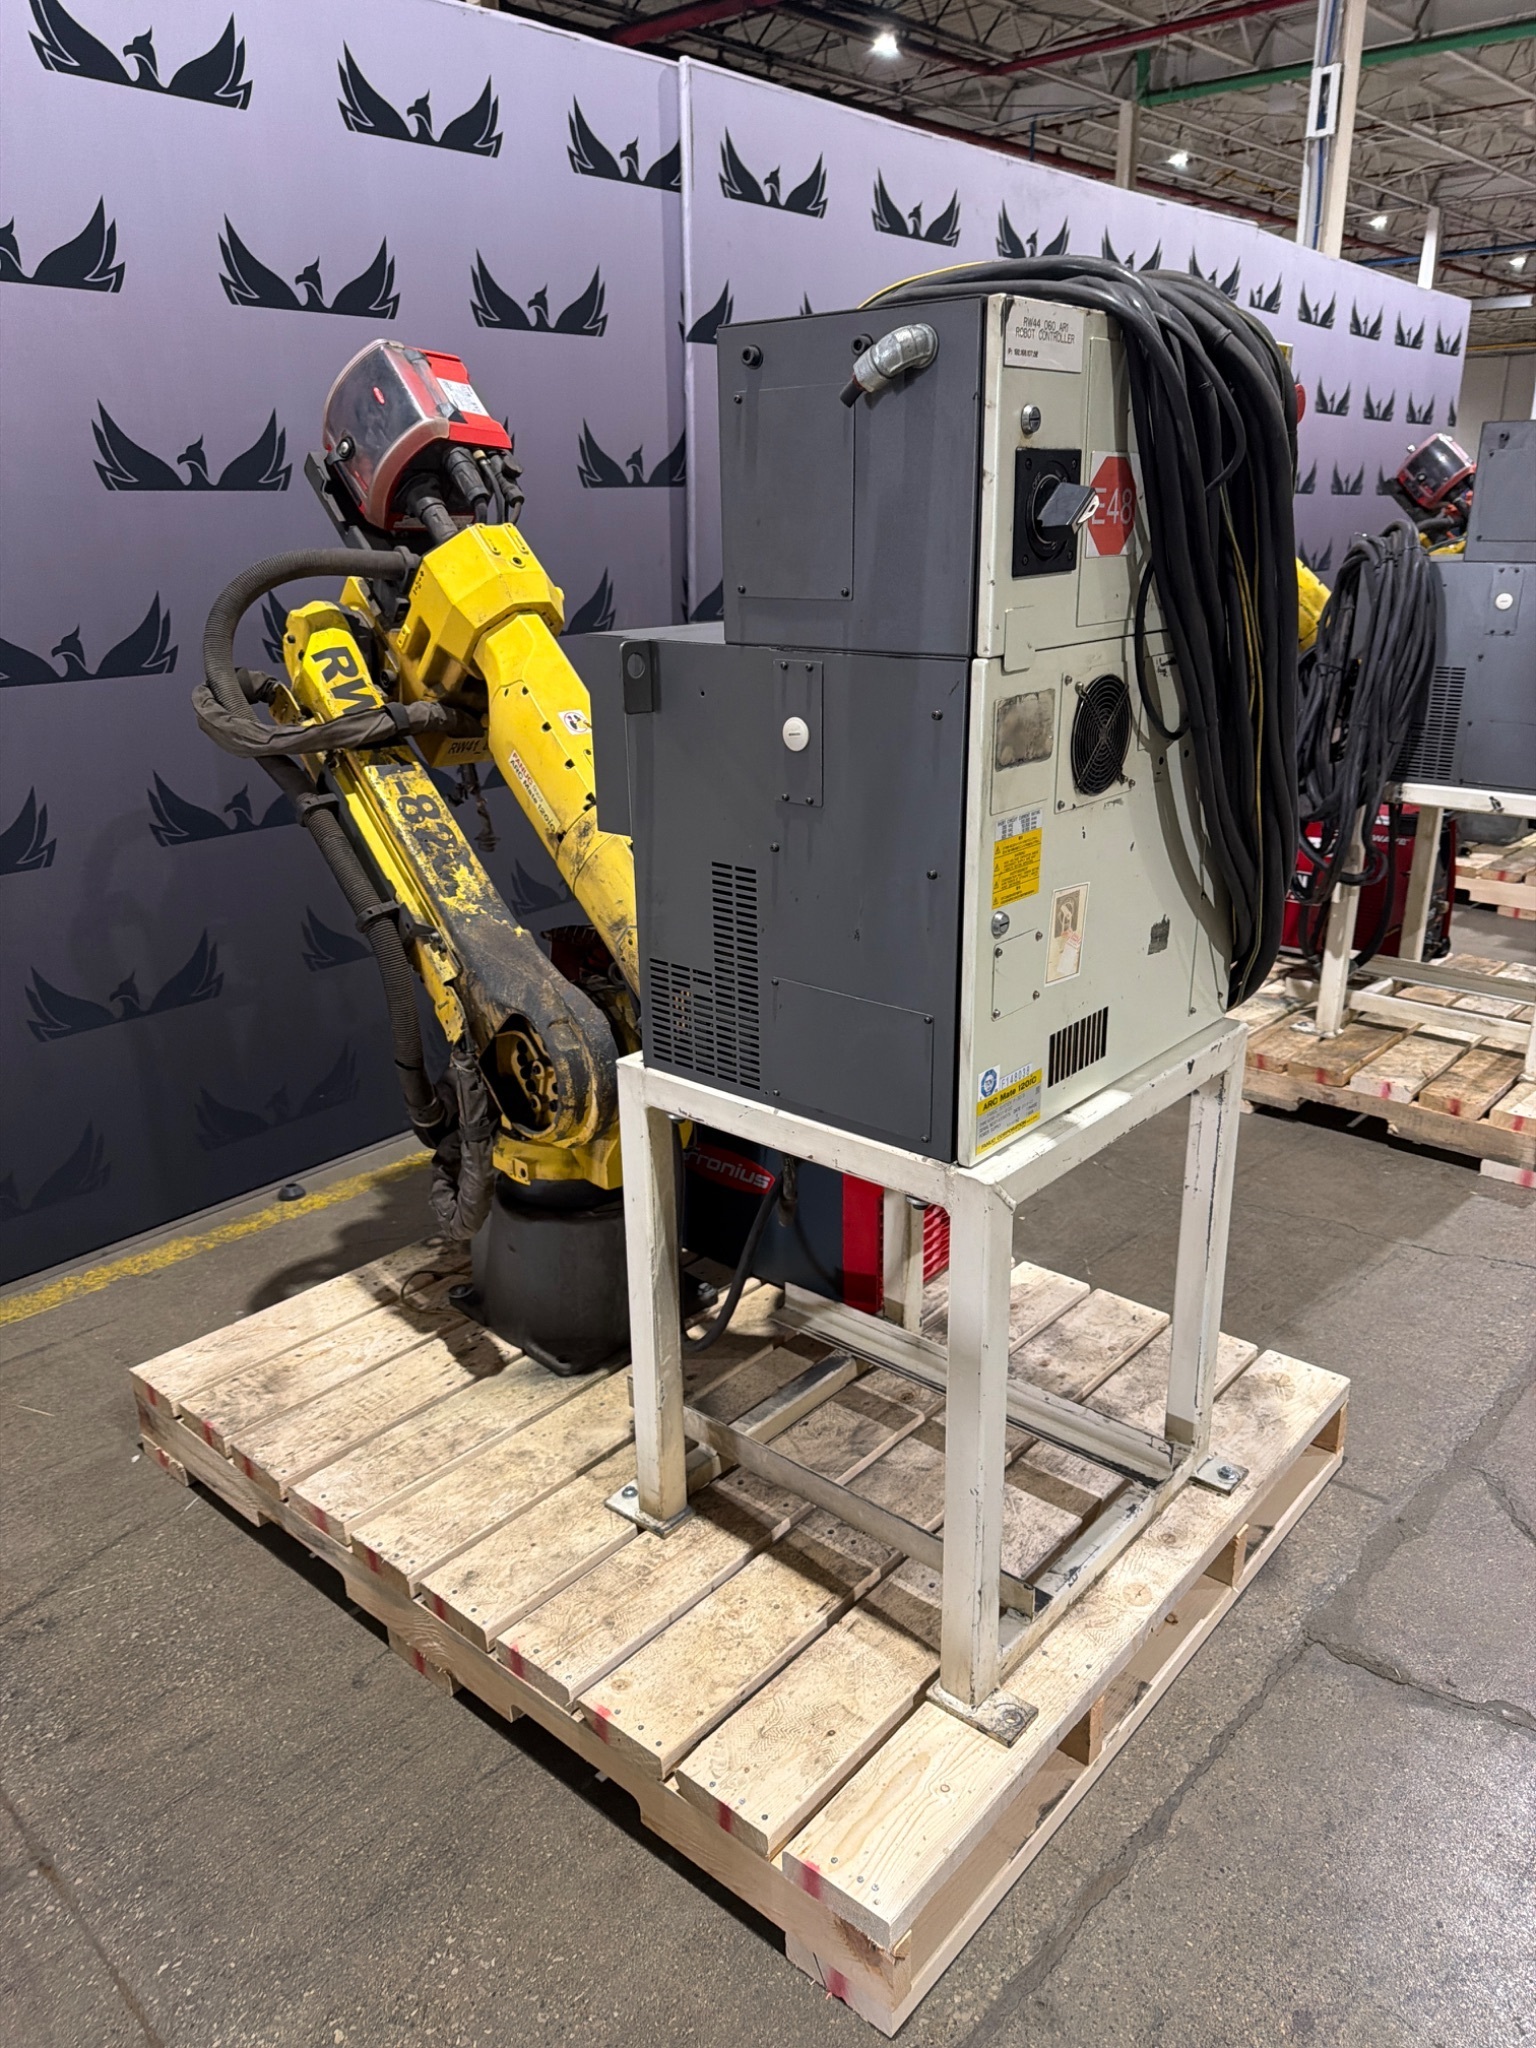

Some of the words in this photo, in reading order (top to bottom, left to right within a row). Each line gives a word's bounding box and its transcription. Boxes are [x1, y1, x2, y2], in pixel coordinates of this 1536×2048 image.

[1015, 326, 1035, 339] ROBOT
[1038, 329, 1075, 344] CONTROLLER
[512, 752, 533, 785] FANUC
[510, 760, 523, 780] ARC
[523, 780, 538, 804] Mate
[1371, 834, 1407, 846] WAE
[982, 1097, 998, 1111] ARC
[1000, 1088, 1016, 1102] Mate
